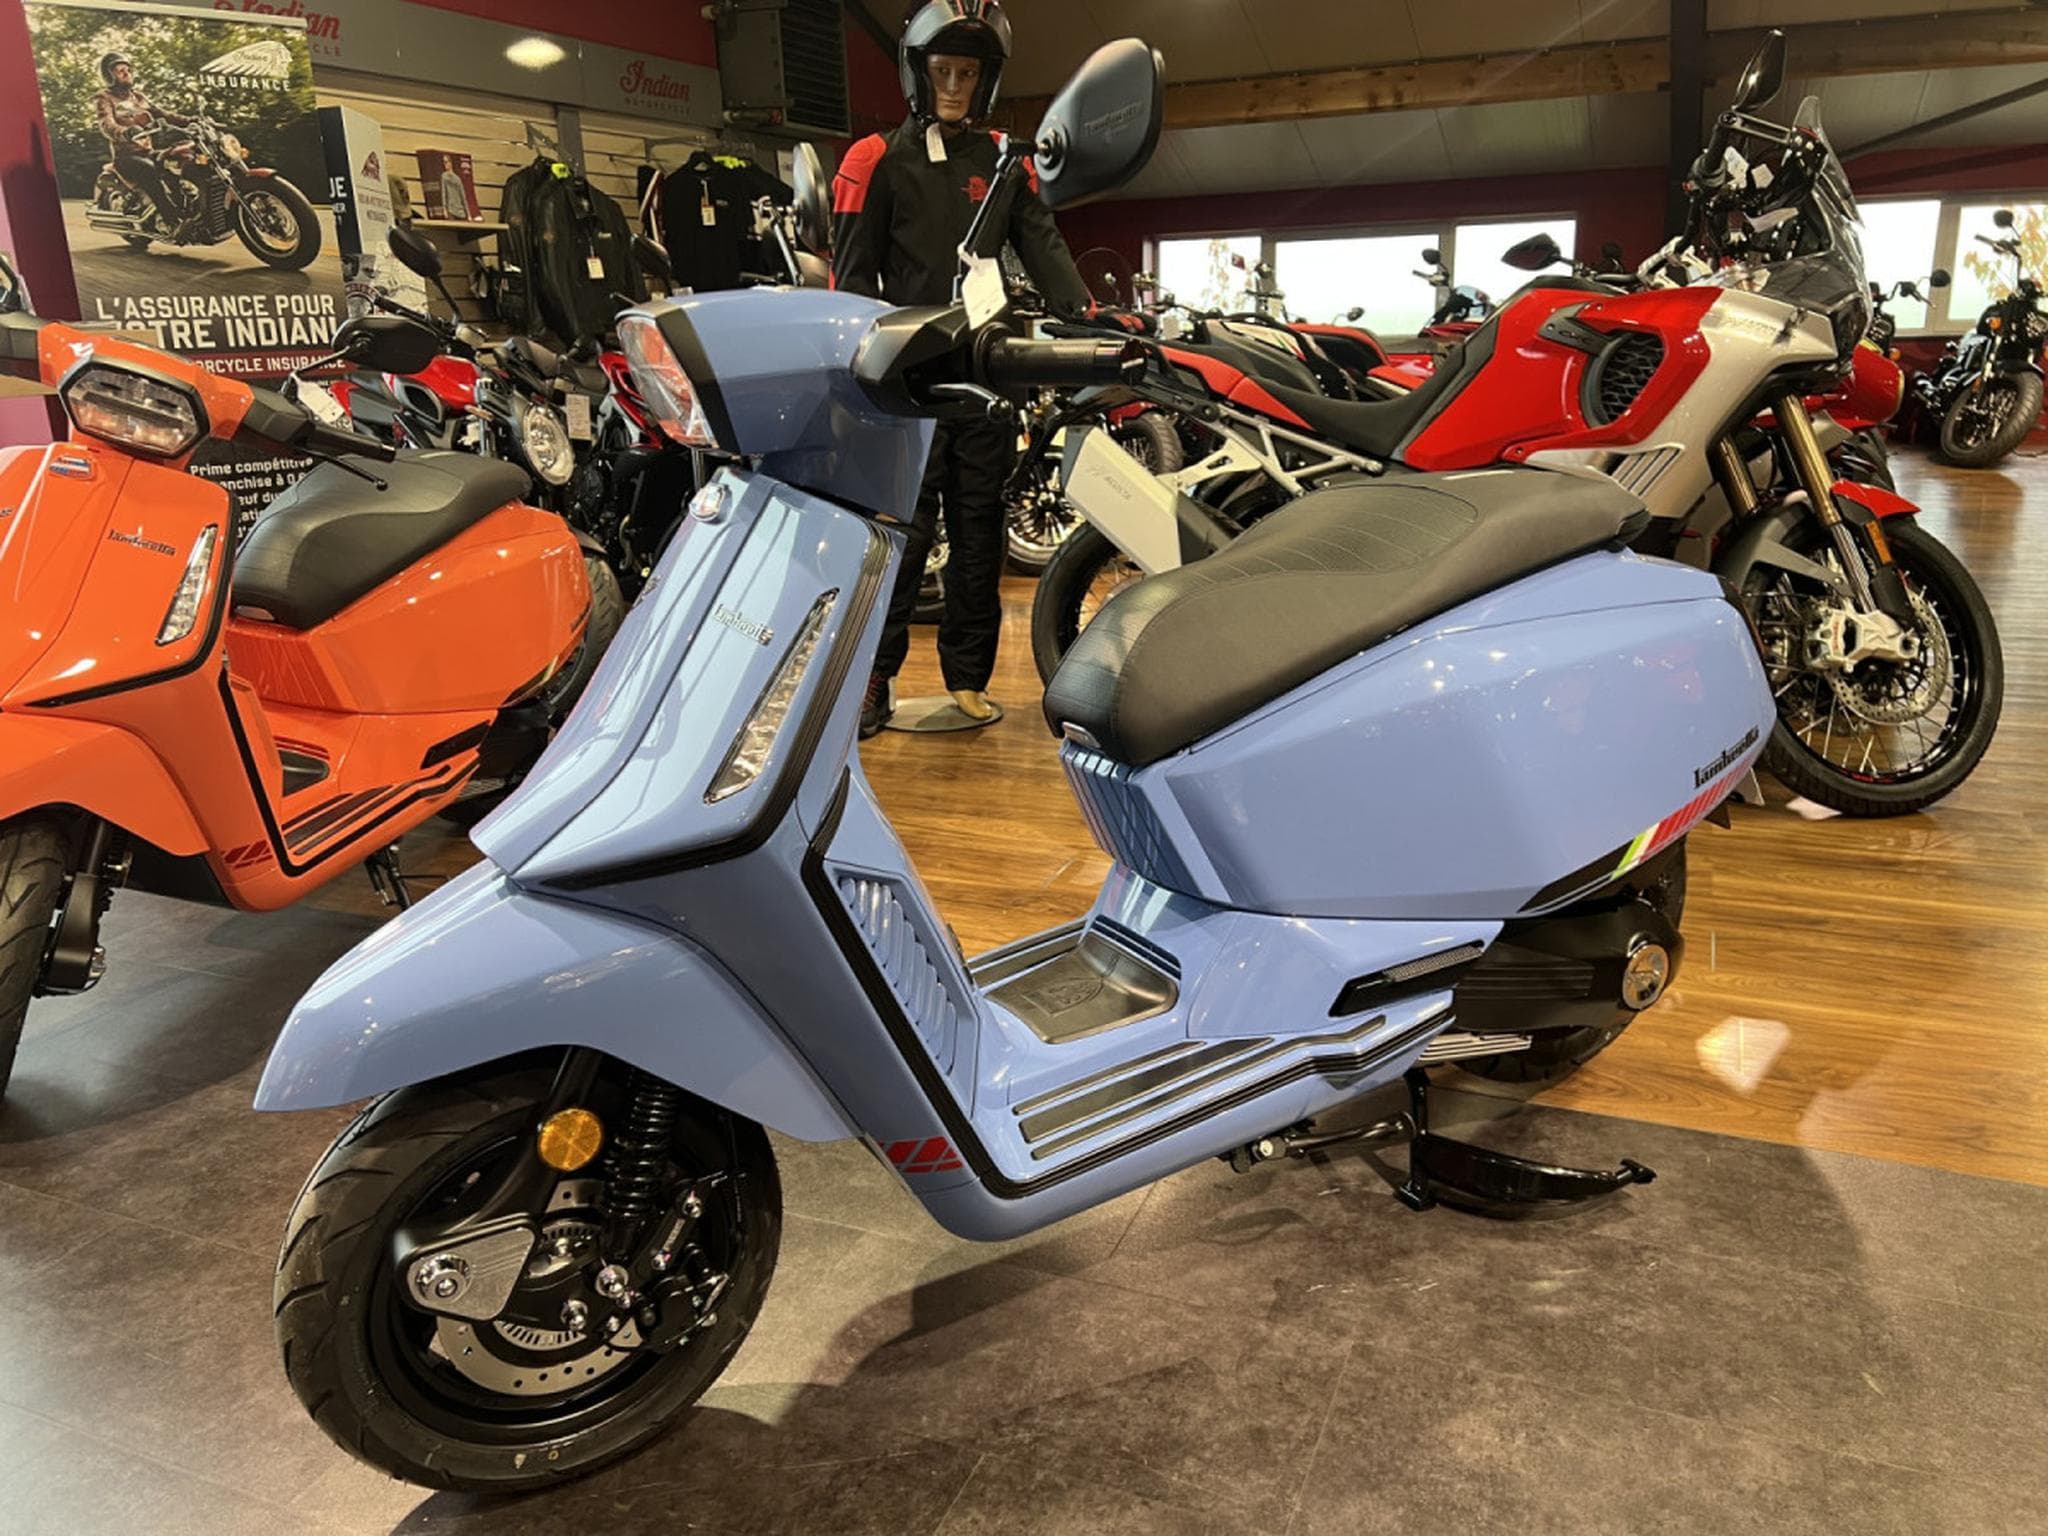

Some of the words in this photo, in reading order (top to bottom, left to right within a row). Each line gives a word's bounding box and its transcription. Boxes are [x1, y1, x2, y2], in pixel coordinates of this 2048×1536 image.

[199, 74, 291, 92] INSURANCE
[620, 60, 689, 102] Indian
[96, 295, 268, 320] L'ASSURANCE
[275, 294, 336, 317] POUR
[116, 319, 216, 349] TRE
[196, 357, 264, 373] RCYCLE
[190, 463, 232, 476] Prime
[220, 475, 272, 491] anchise
